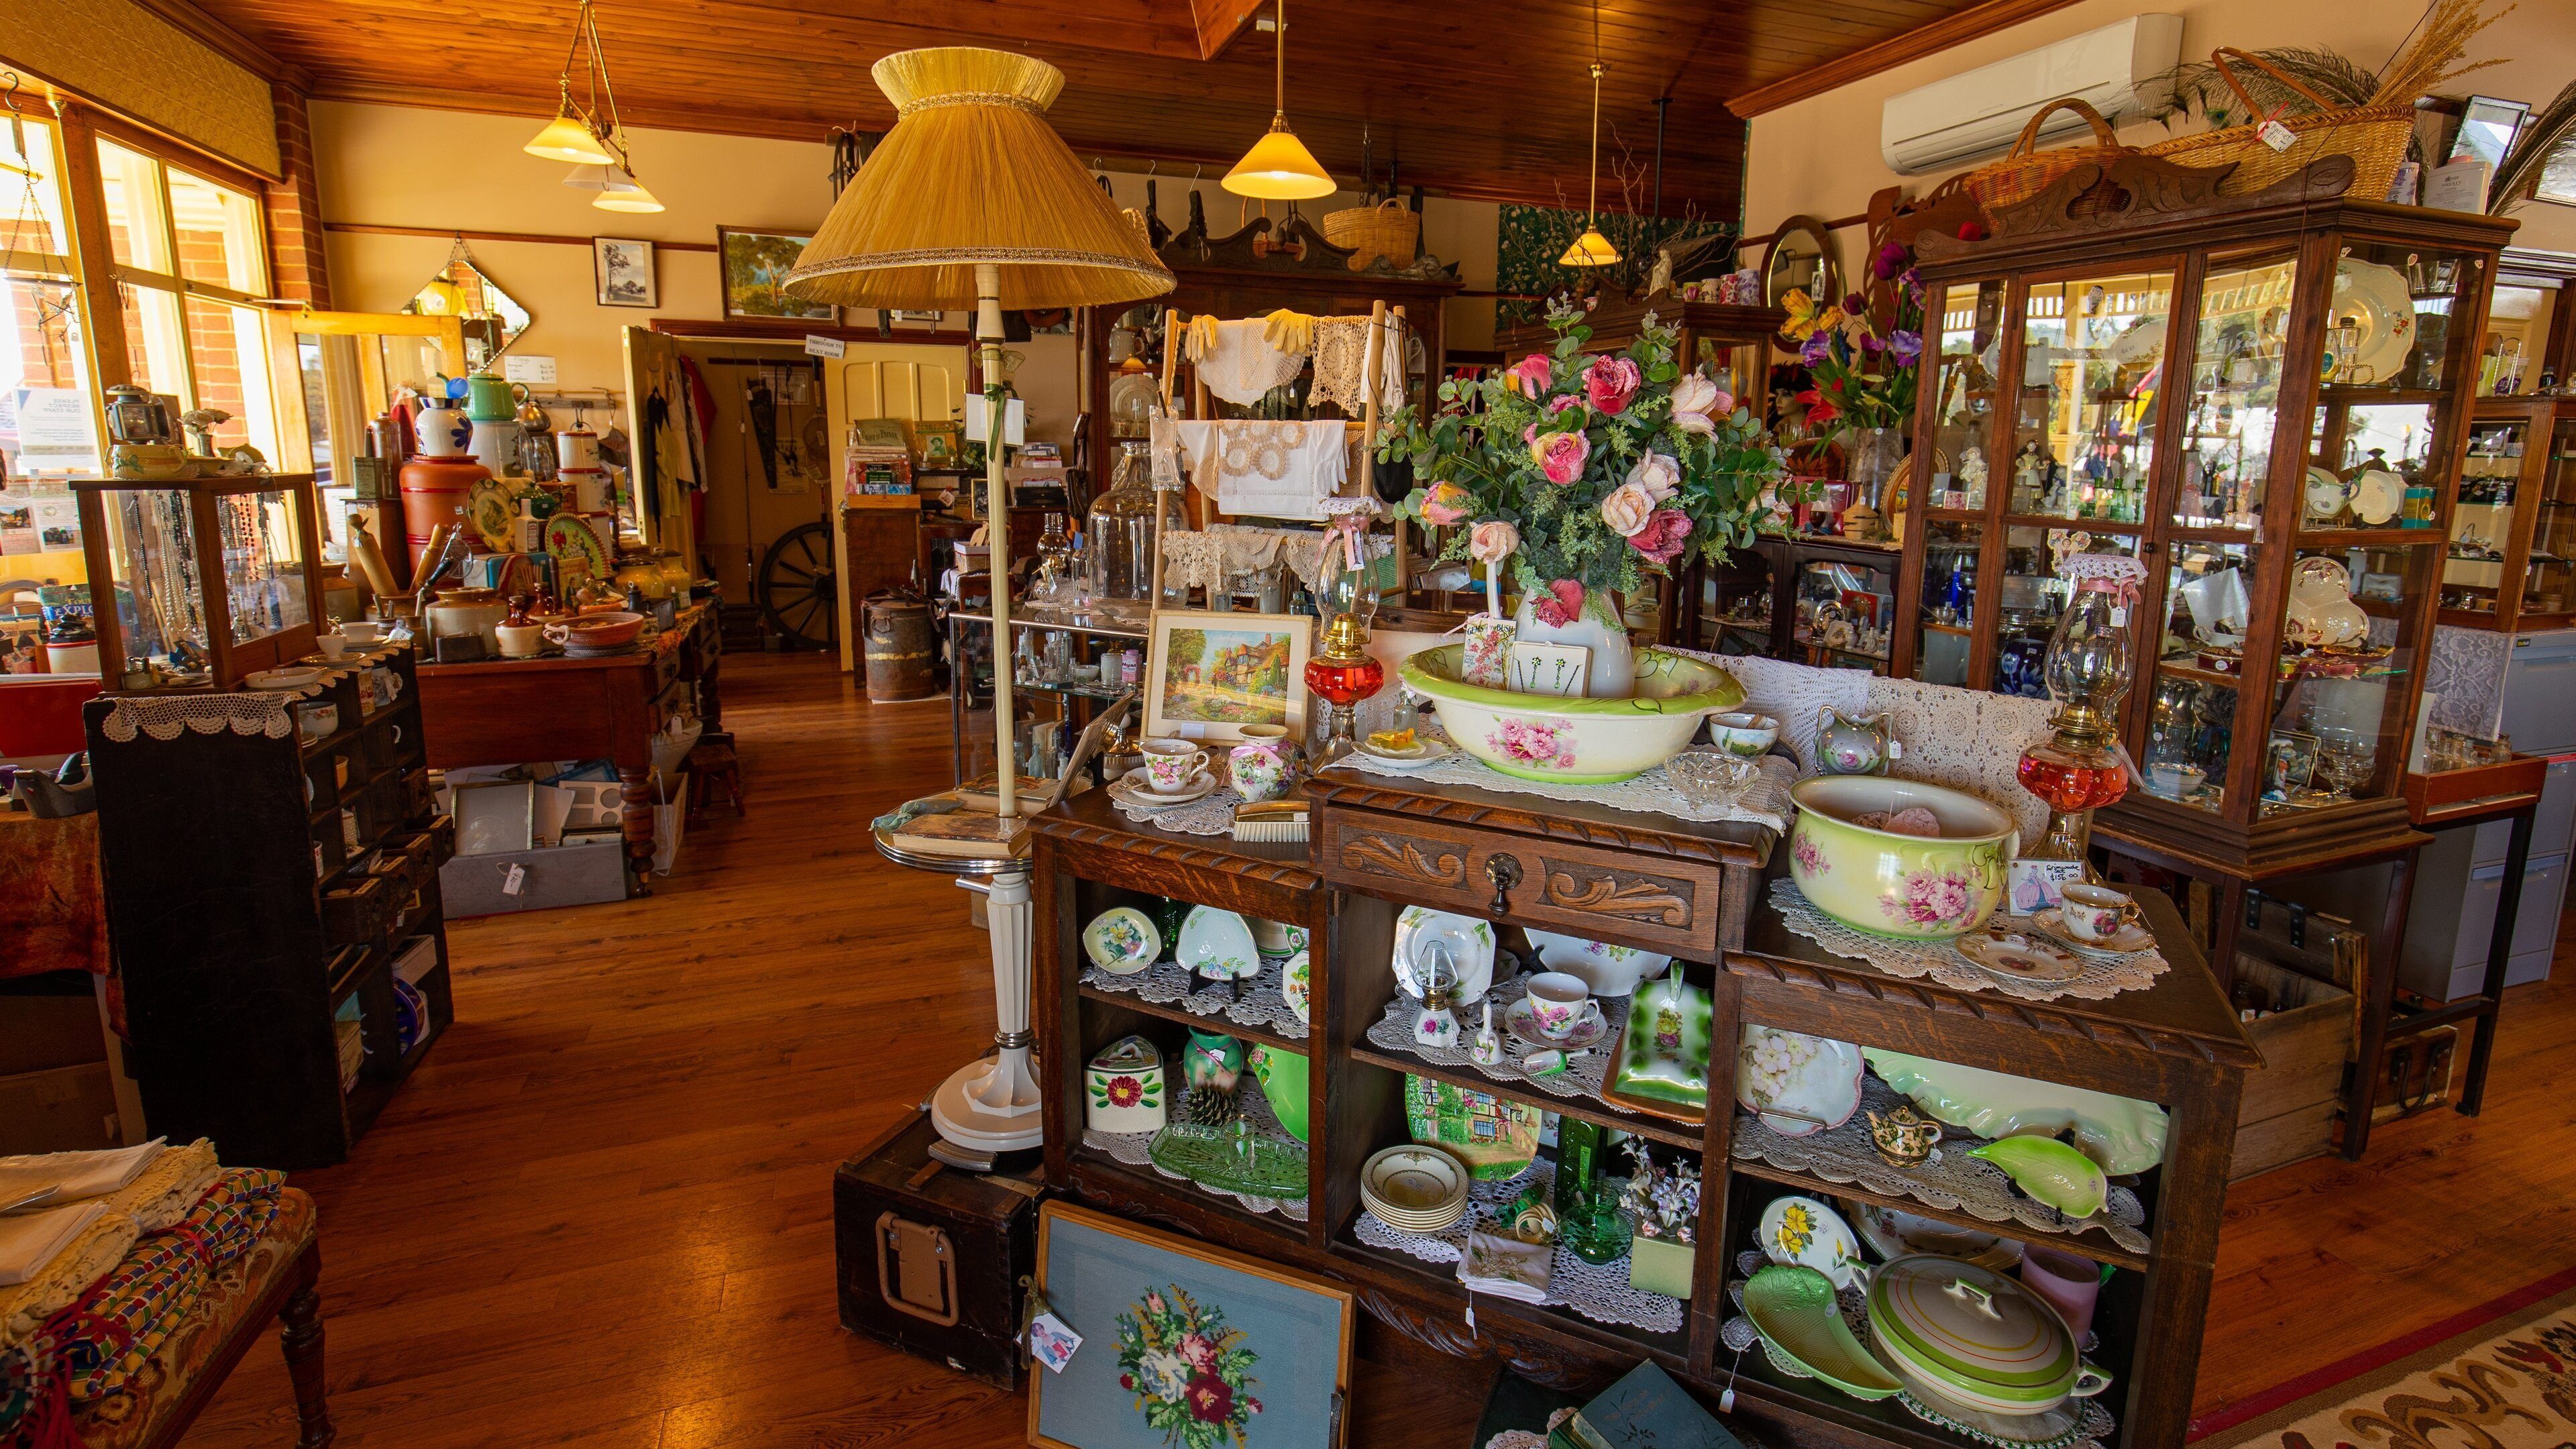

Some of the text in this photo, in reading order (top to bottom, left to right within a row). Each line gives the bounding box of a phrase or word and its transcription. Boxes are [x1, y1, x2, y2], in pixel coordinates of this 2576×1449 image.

[809, 339, 834, 347] THROUGH
[1467, 625, 1484, 635] GEMS
[1497, 624, 1515, 632] BUSH
